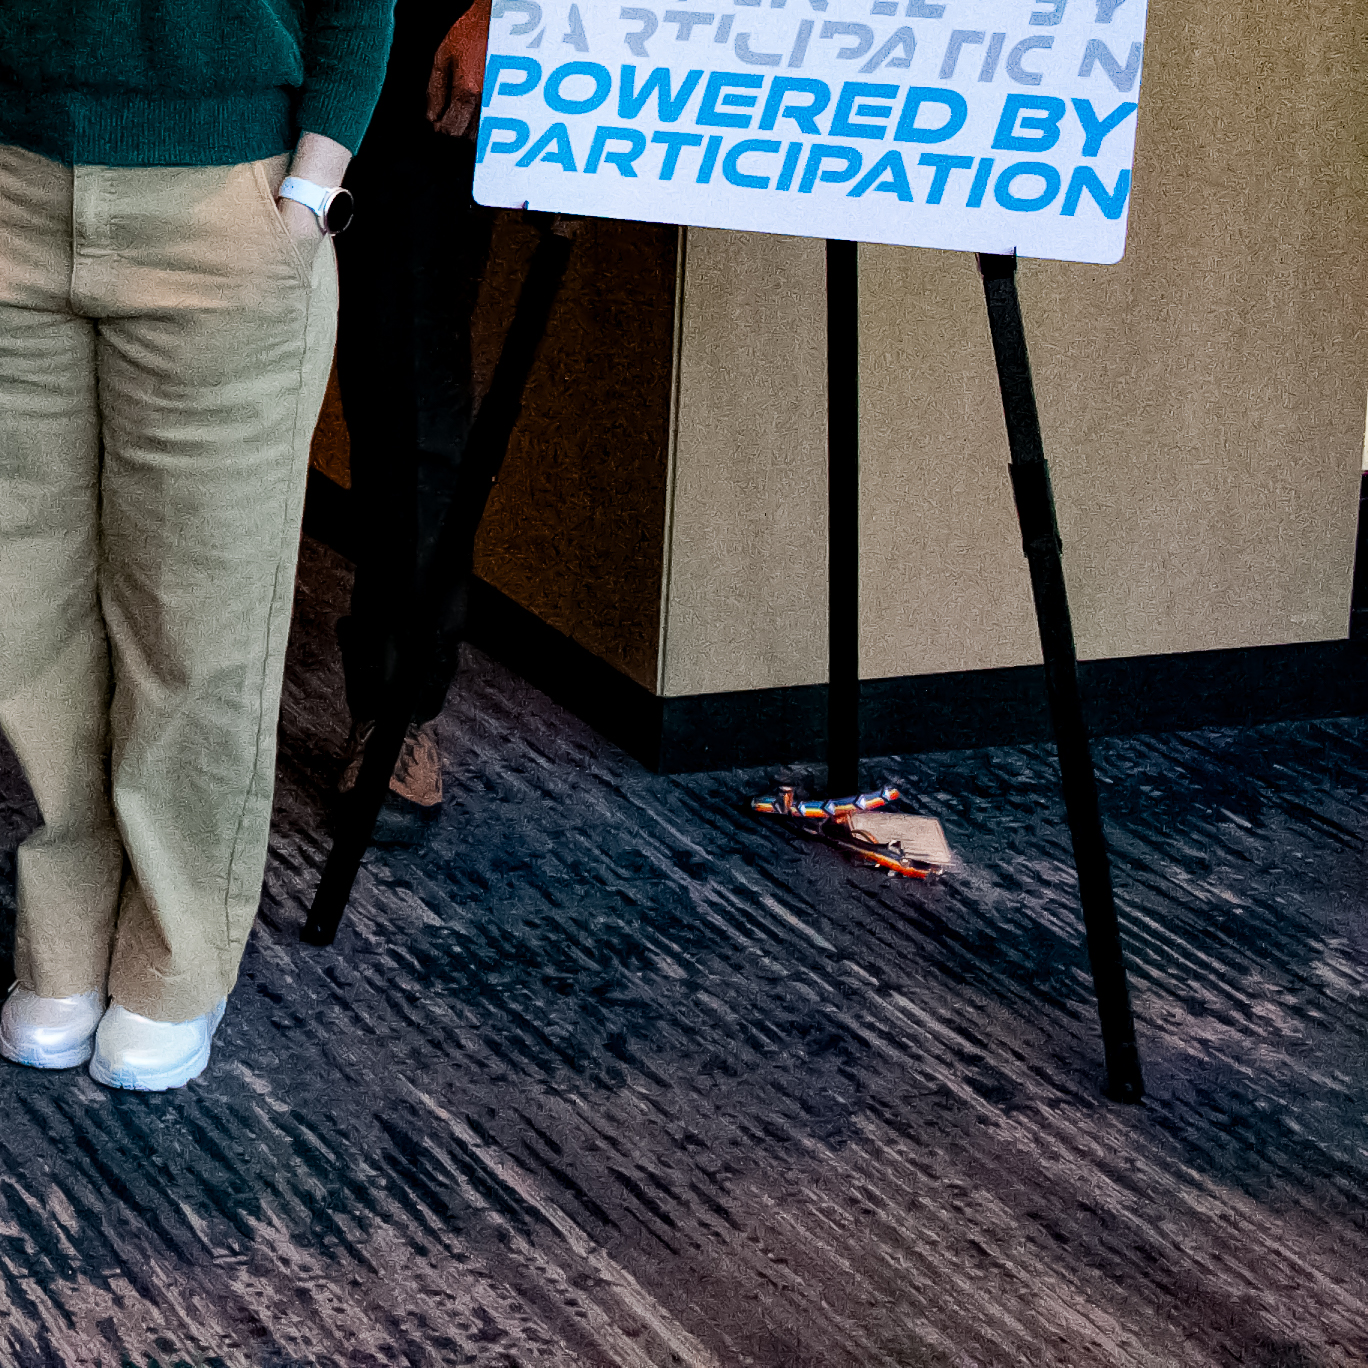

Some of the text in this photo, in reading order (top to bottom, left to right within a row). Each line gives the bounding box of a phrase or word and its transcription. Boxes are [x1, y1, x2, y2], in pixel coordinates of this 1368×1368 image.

[481, 53, 1137, 158] POWERED BY
[475, 116, 1131, 220] PARTICIPATION
